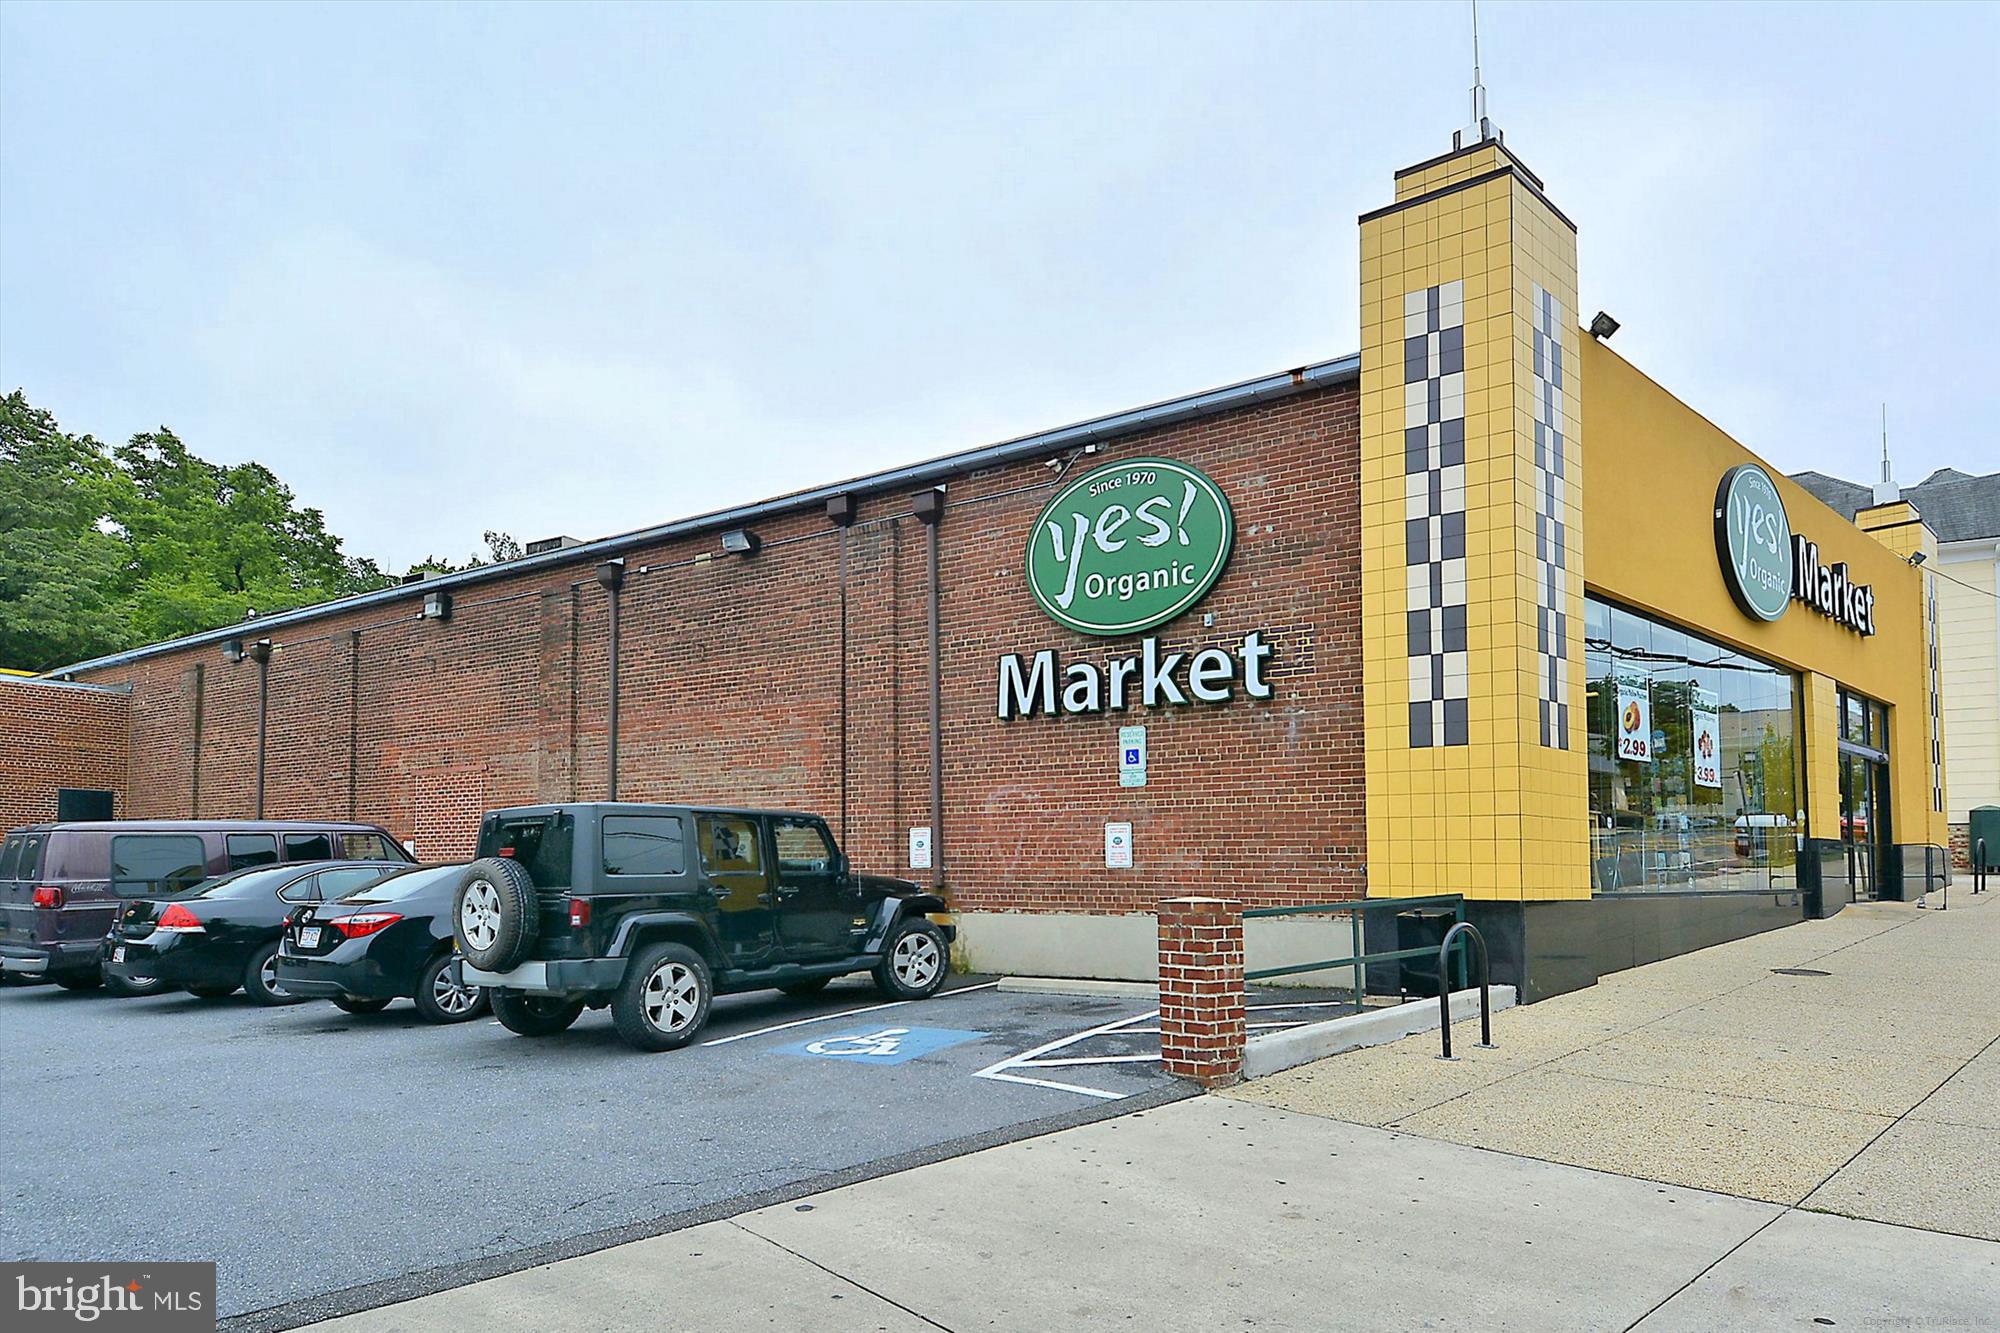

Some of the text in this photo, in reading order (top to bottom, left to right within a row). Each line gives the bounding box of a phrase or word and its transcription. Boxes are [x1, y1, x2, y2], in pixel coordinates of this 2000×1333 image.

[1089, 472, 1156, 497] Since 1970
[1749, 477, 1762, 489] Since
[1085, 561, 1195, 601] Organic
[1750, 558, 1786, 595] Organic
[1799, 535, 1874, 636] Market
[998, 633, 1272, 719] Market
